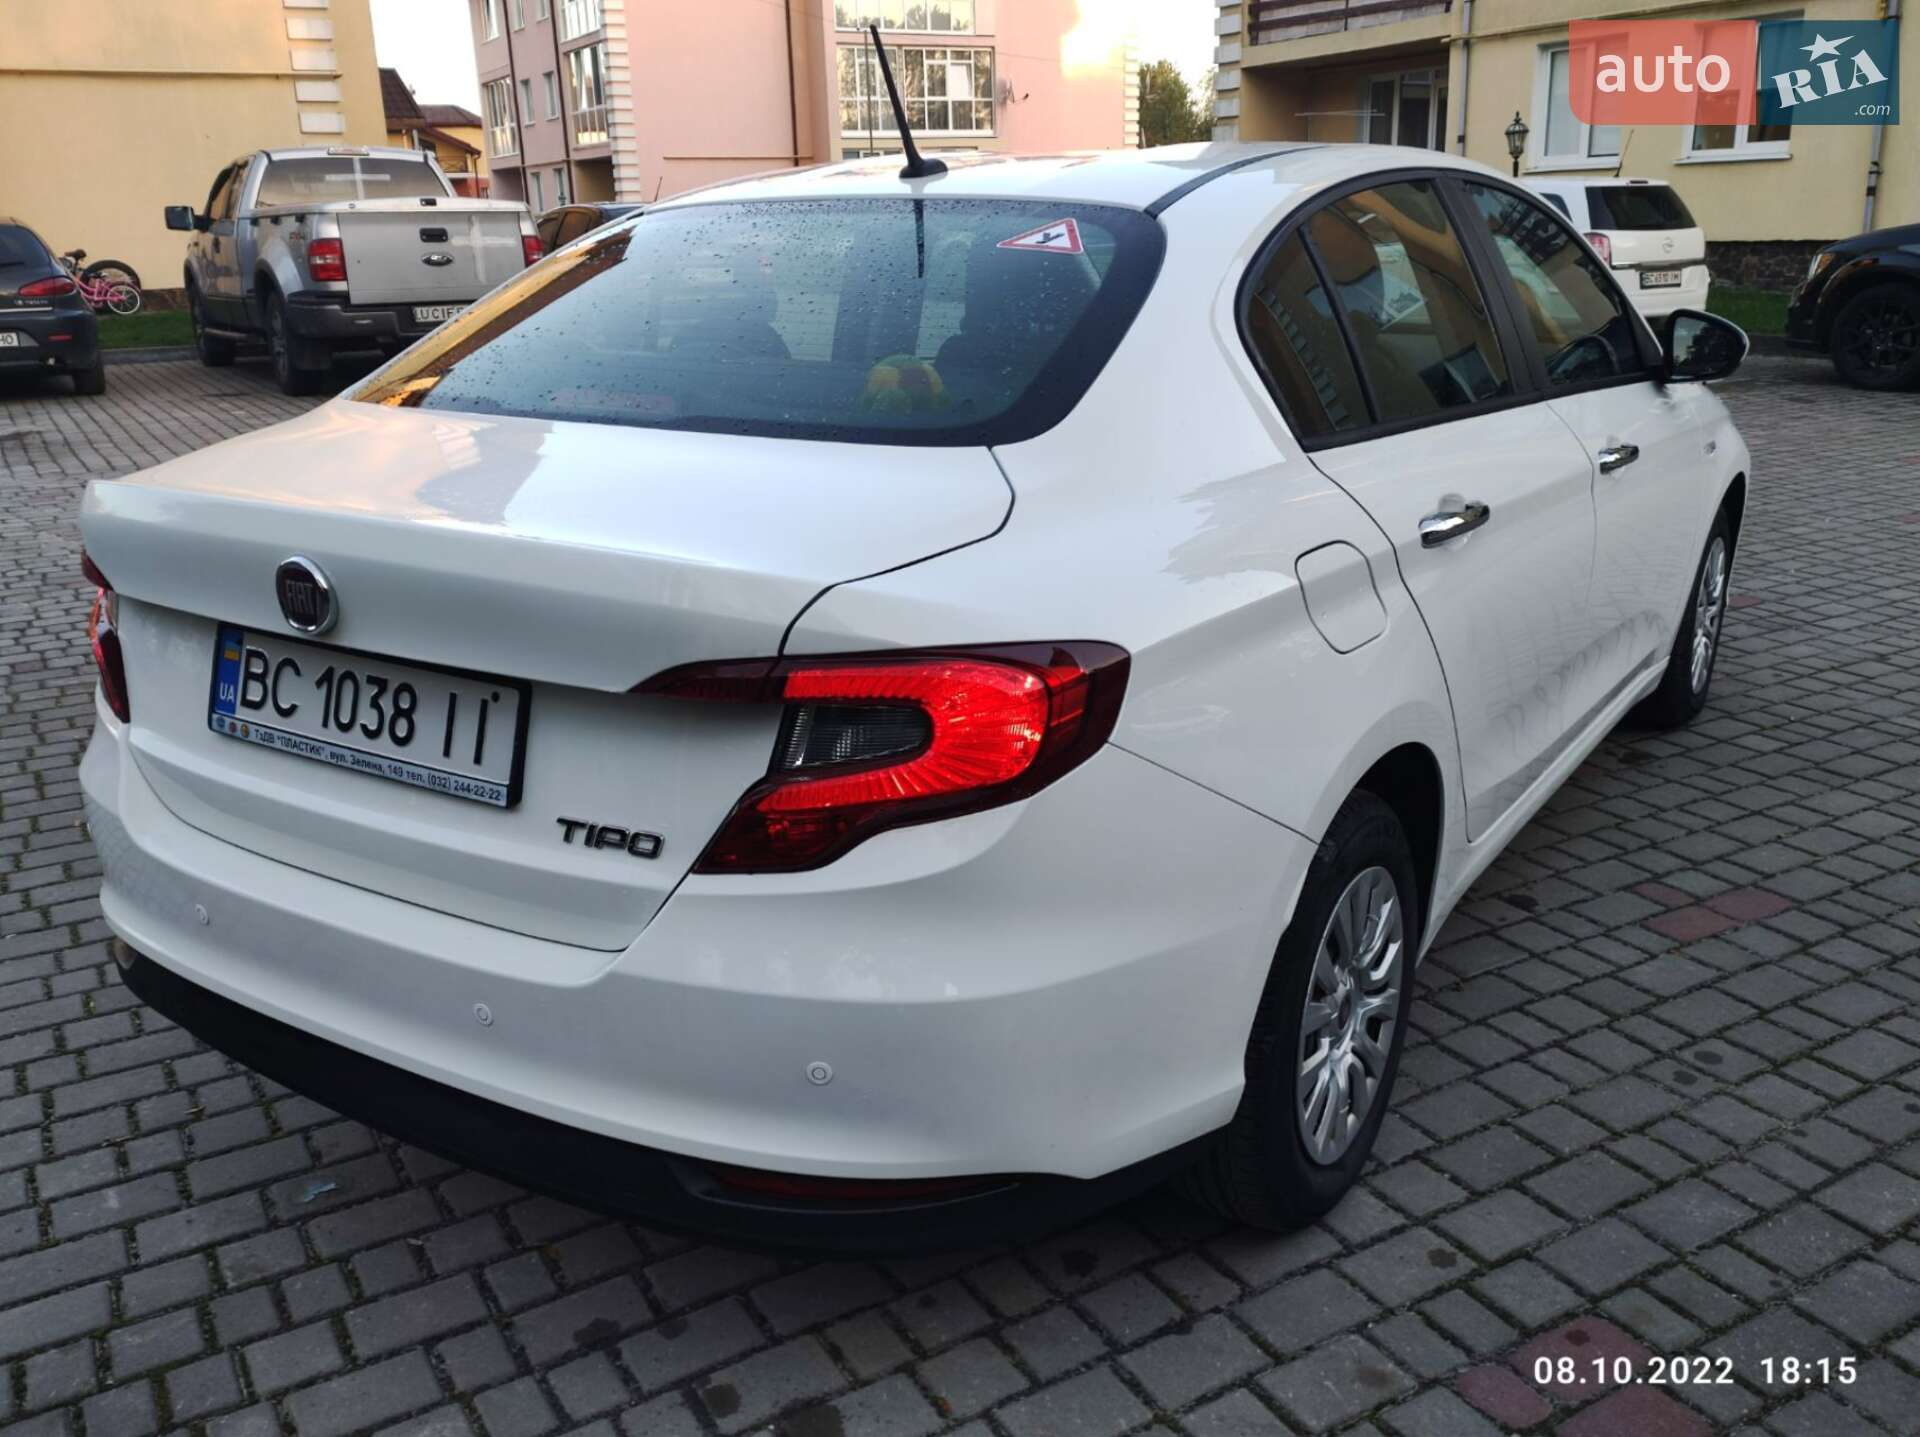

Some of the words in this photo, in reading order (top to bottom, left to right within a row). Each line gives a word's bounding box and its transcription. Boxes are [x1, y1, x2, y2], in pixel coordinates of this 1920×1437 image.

[219, 682, 235, 704] UA
[240, 647, 302, 718] BC
[315, 666, 418, 747] 1038
[329, 751, 348, 765] вул.
[350, 754, 385, 774] Зелена,
[388, 764, 404, 778] 149
[406, 771, 425, 784] тел.
[428, 773, 451, 790] (032)
[454, 780, 502, 801] 244-22-22
[556, 816, 665, 860] TIPO
